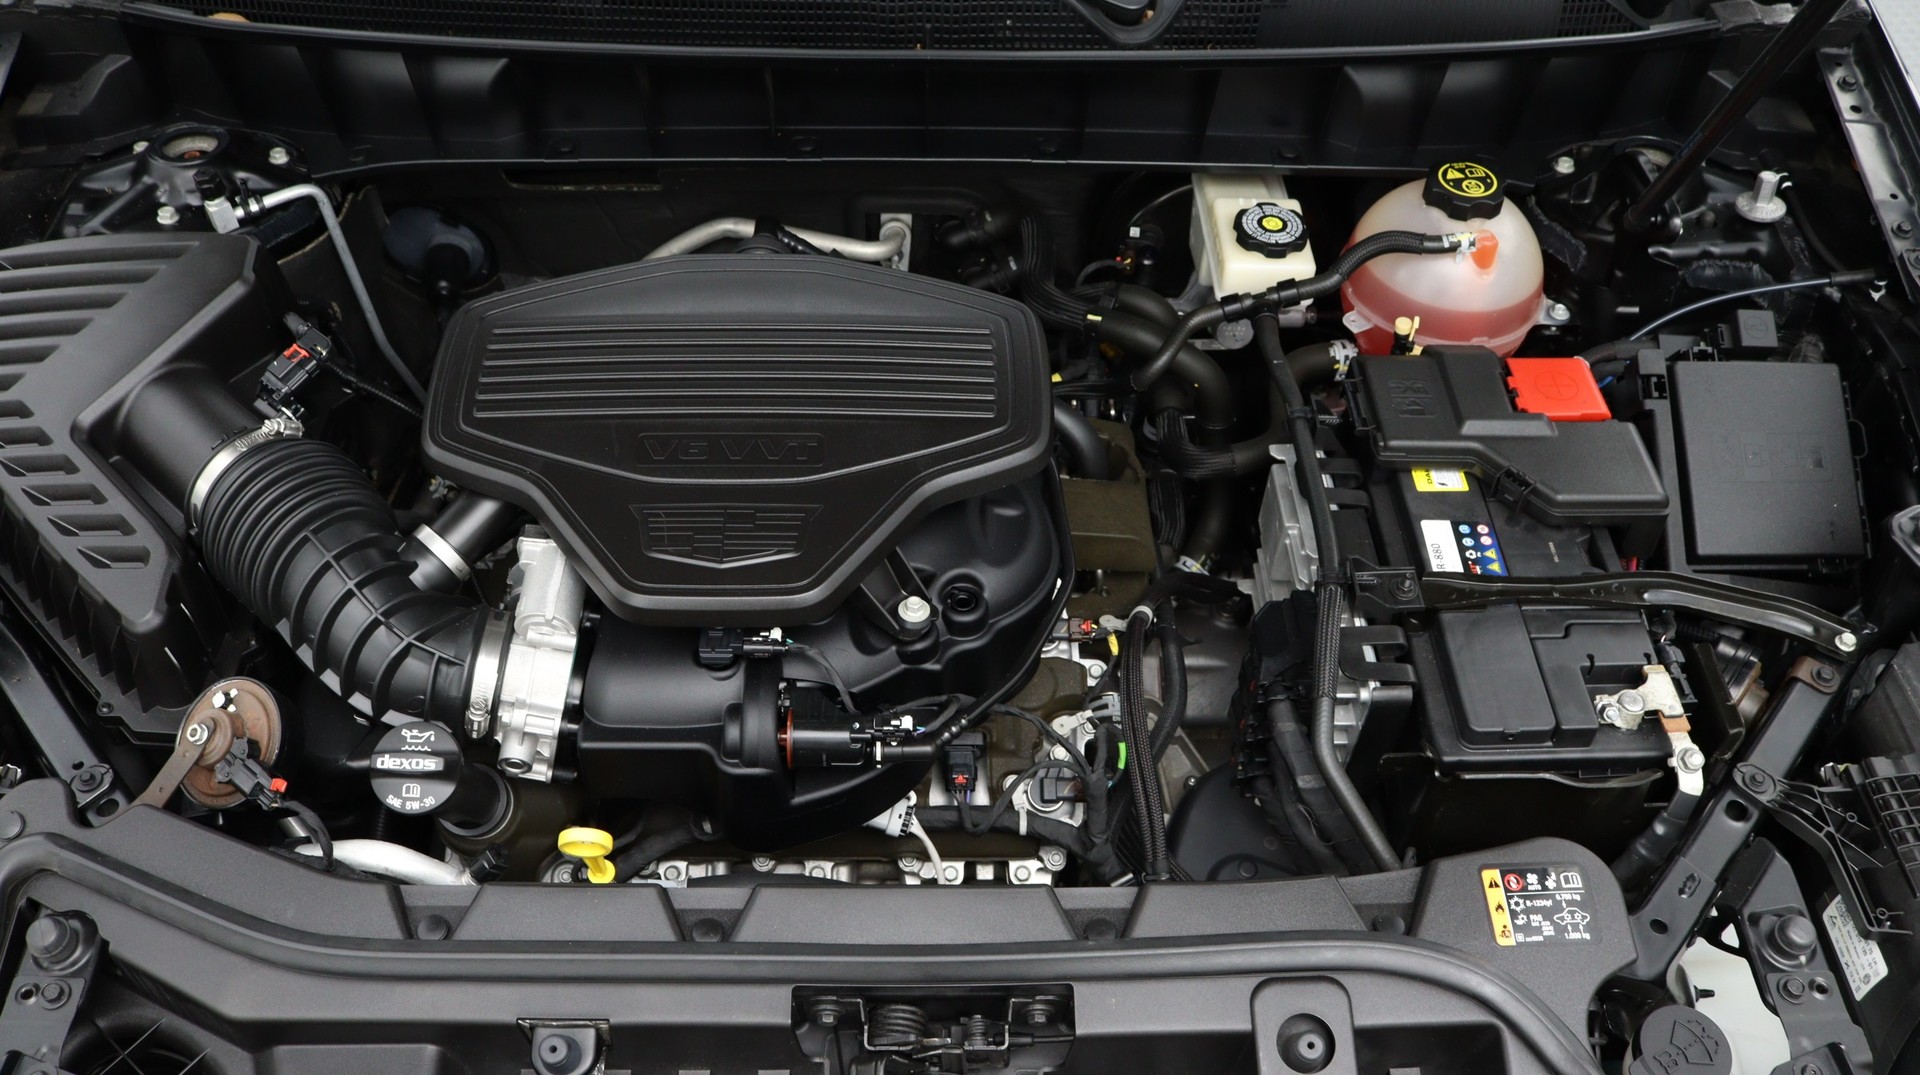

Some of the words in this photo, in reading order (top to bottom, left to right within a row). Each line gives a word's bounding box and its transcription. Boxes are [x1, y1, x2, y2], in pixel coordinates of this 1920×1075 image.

[644, 439, 708, 460] V6
[720, 439, 818, 460] VVT
[376, 754, 437, 770] dexos
[386, 794, 403, 808] SAE
[405, 796, 436, 810] 5W-30
